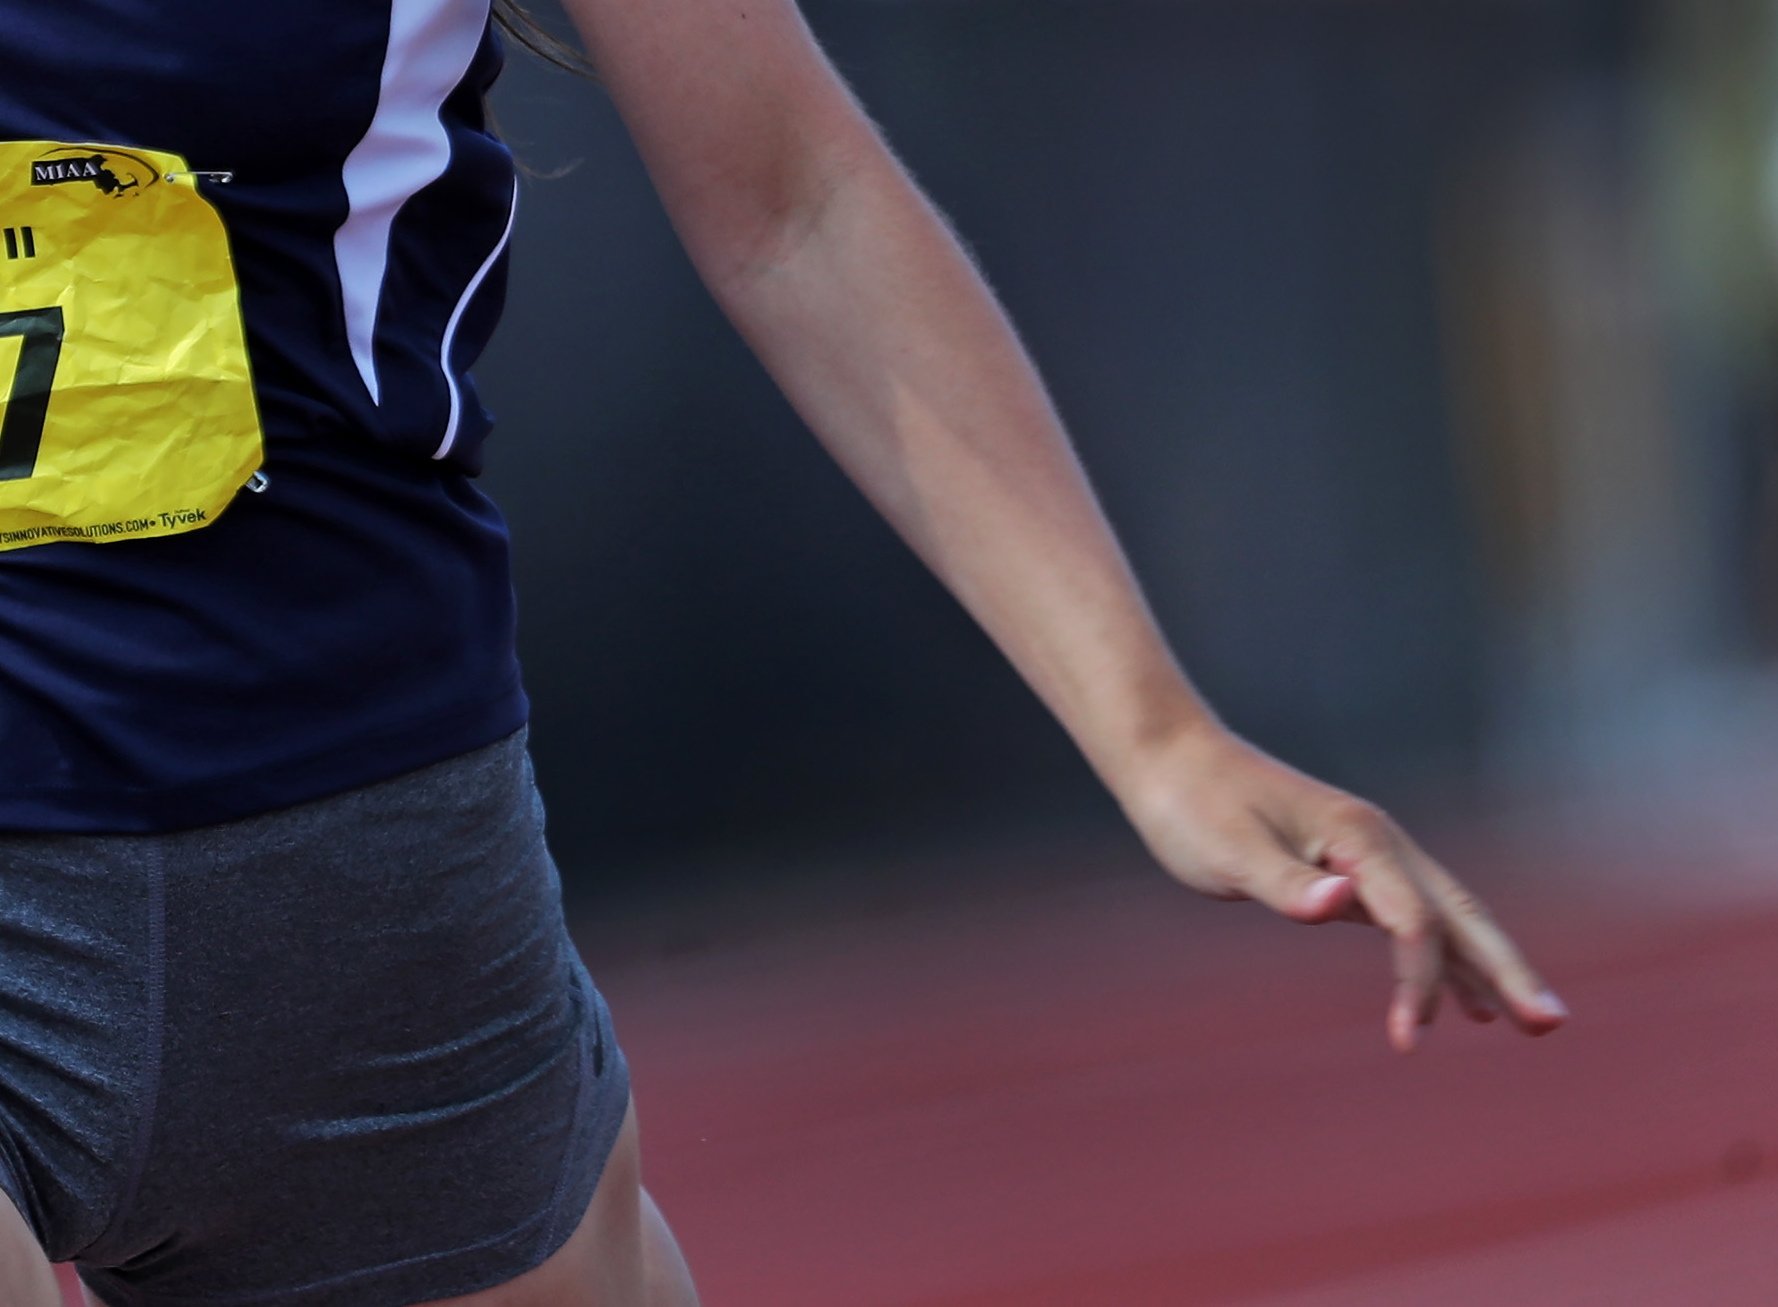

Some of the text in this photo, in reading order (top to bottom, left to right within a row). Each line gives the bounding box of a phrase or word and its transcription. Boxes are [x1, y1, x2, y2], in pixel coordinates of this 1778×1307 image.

[34, 161, 98, 181] MIAA
[3, 226, 36, 260] II
[157, 508, 206, 529] Tyvek
